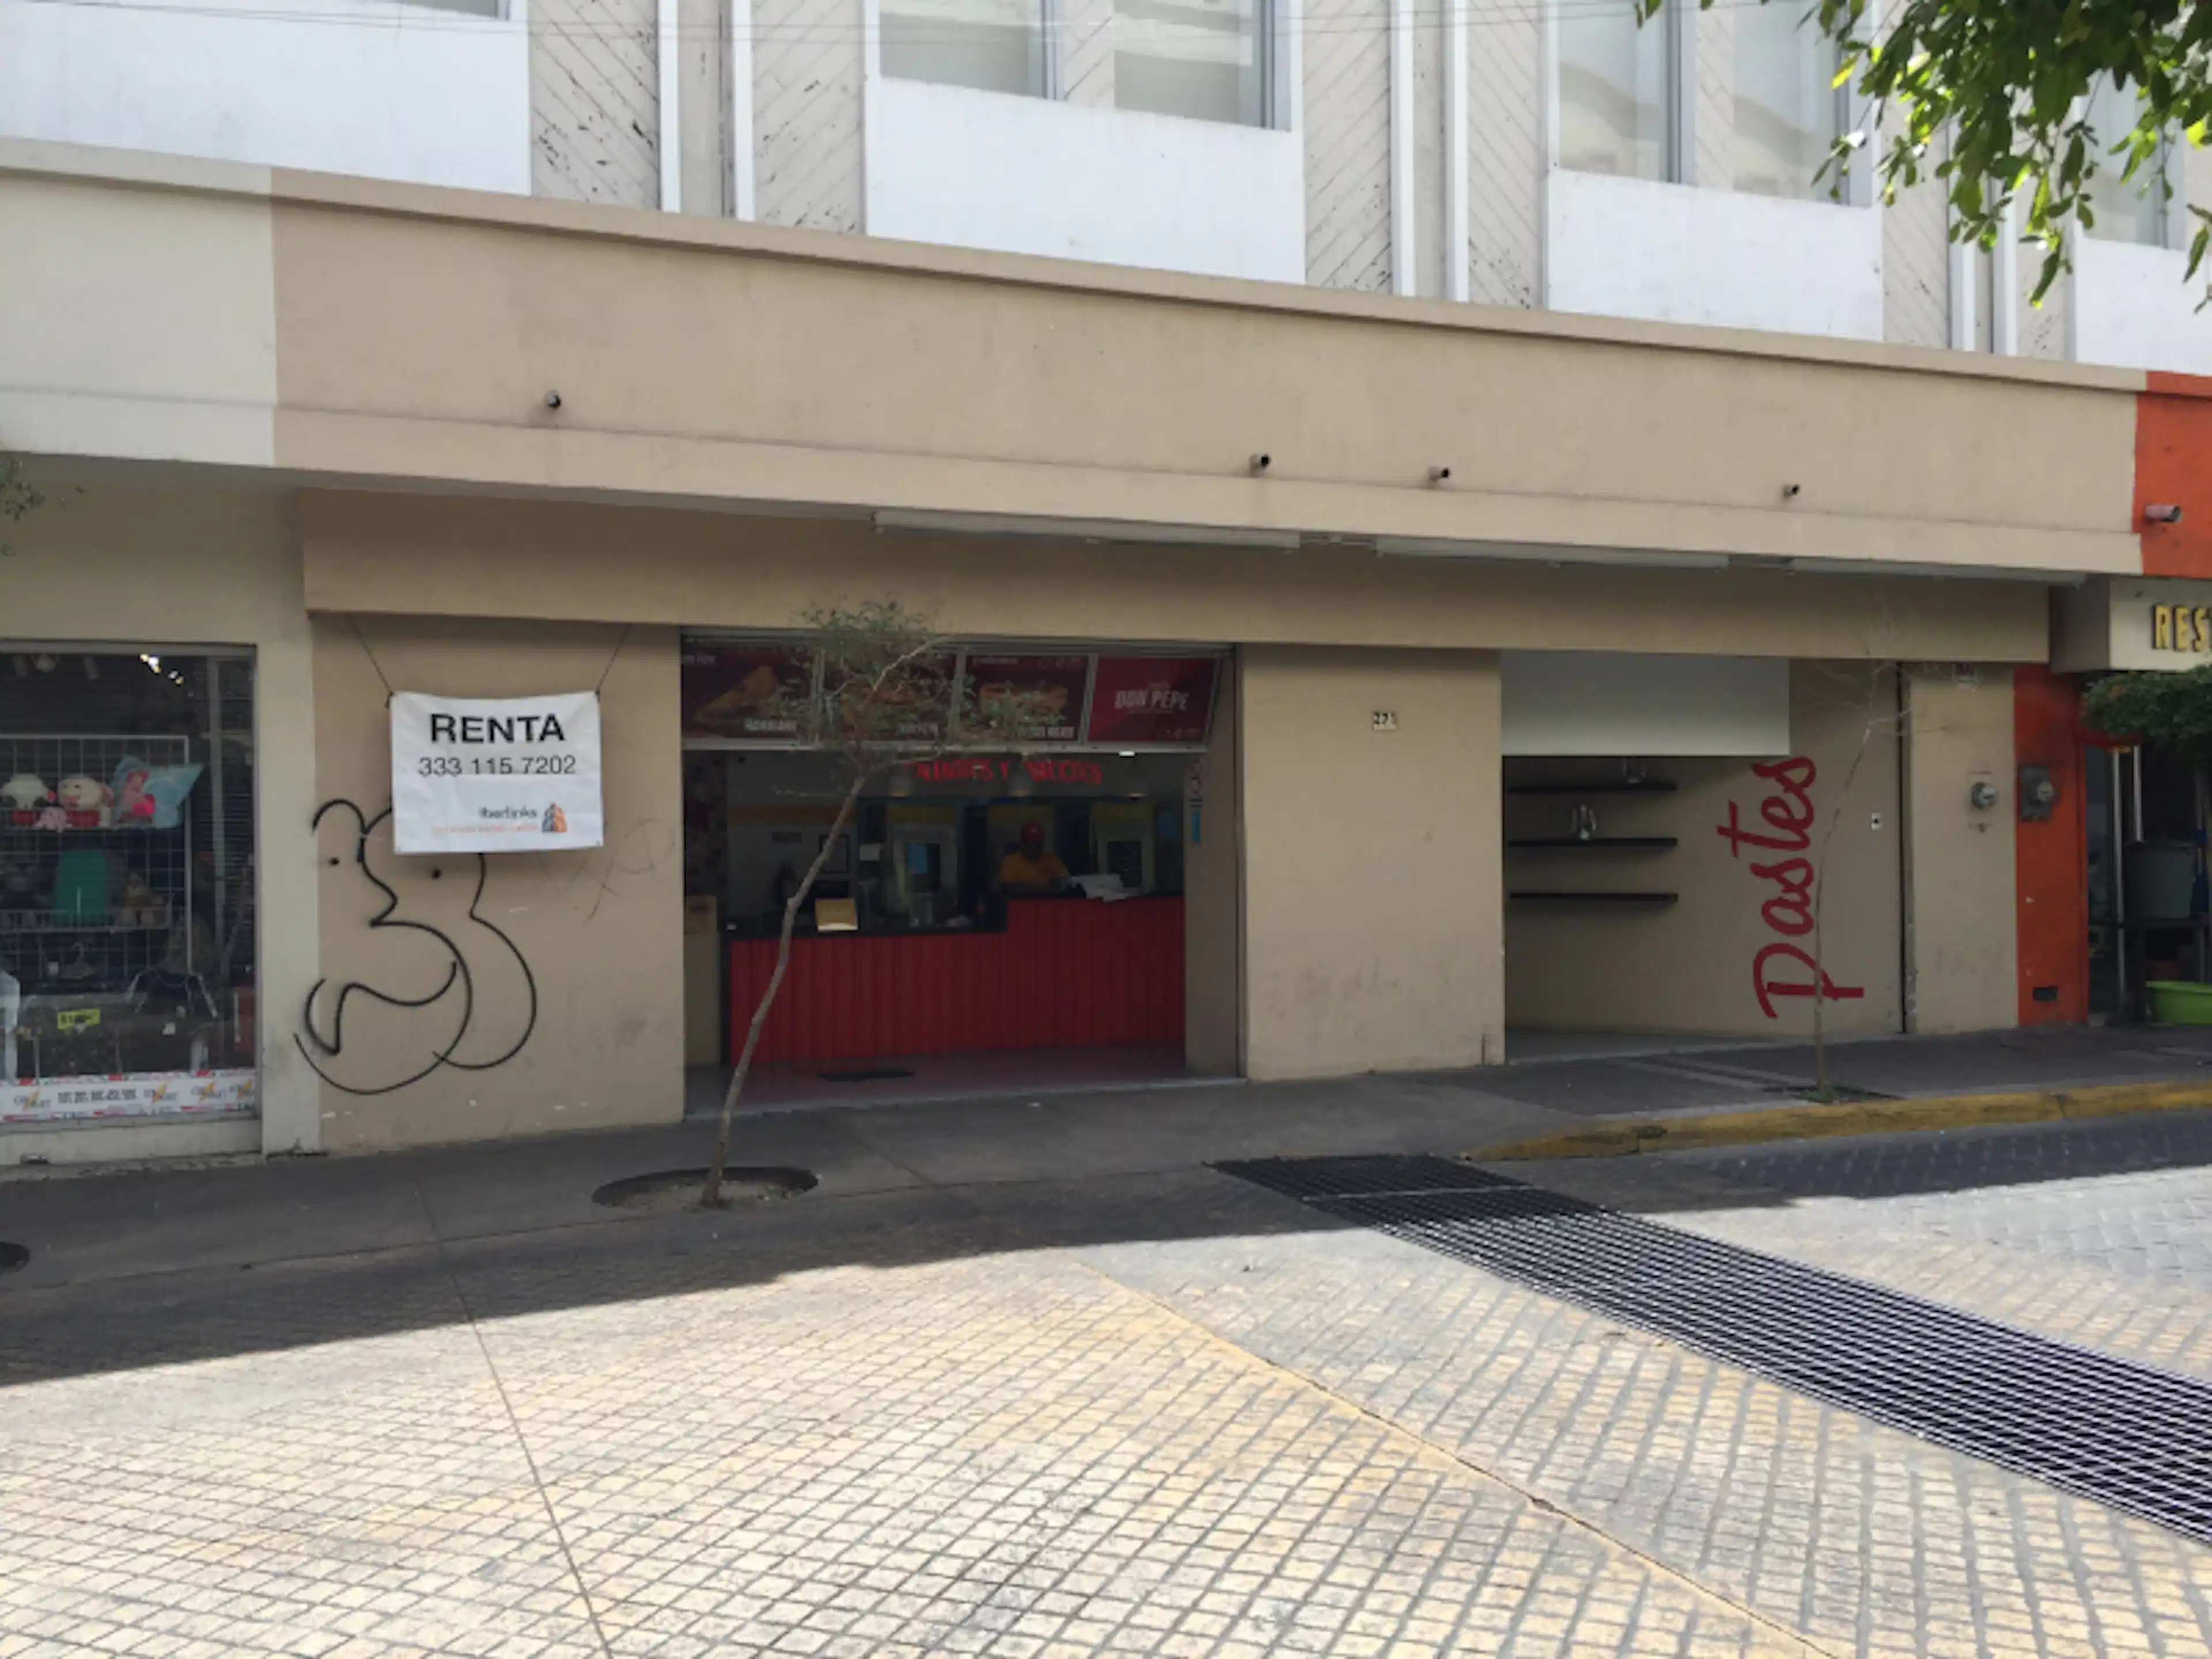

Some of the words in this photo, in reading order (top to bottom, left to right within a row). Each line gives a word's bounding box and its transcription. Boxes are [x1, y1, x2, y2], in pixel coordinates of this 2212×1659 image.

[2151, 603, 2212, 653] RES
[1150, 690, 1190, 712] PEPE
[430, 712, 566, 744] RENTA
[418, 755, 462, 778] 333
[472, 756, 513, 775] 115
[521, 754, 577, 775] 7202
[1715, 756, 1865, 1020] Pastes
